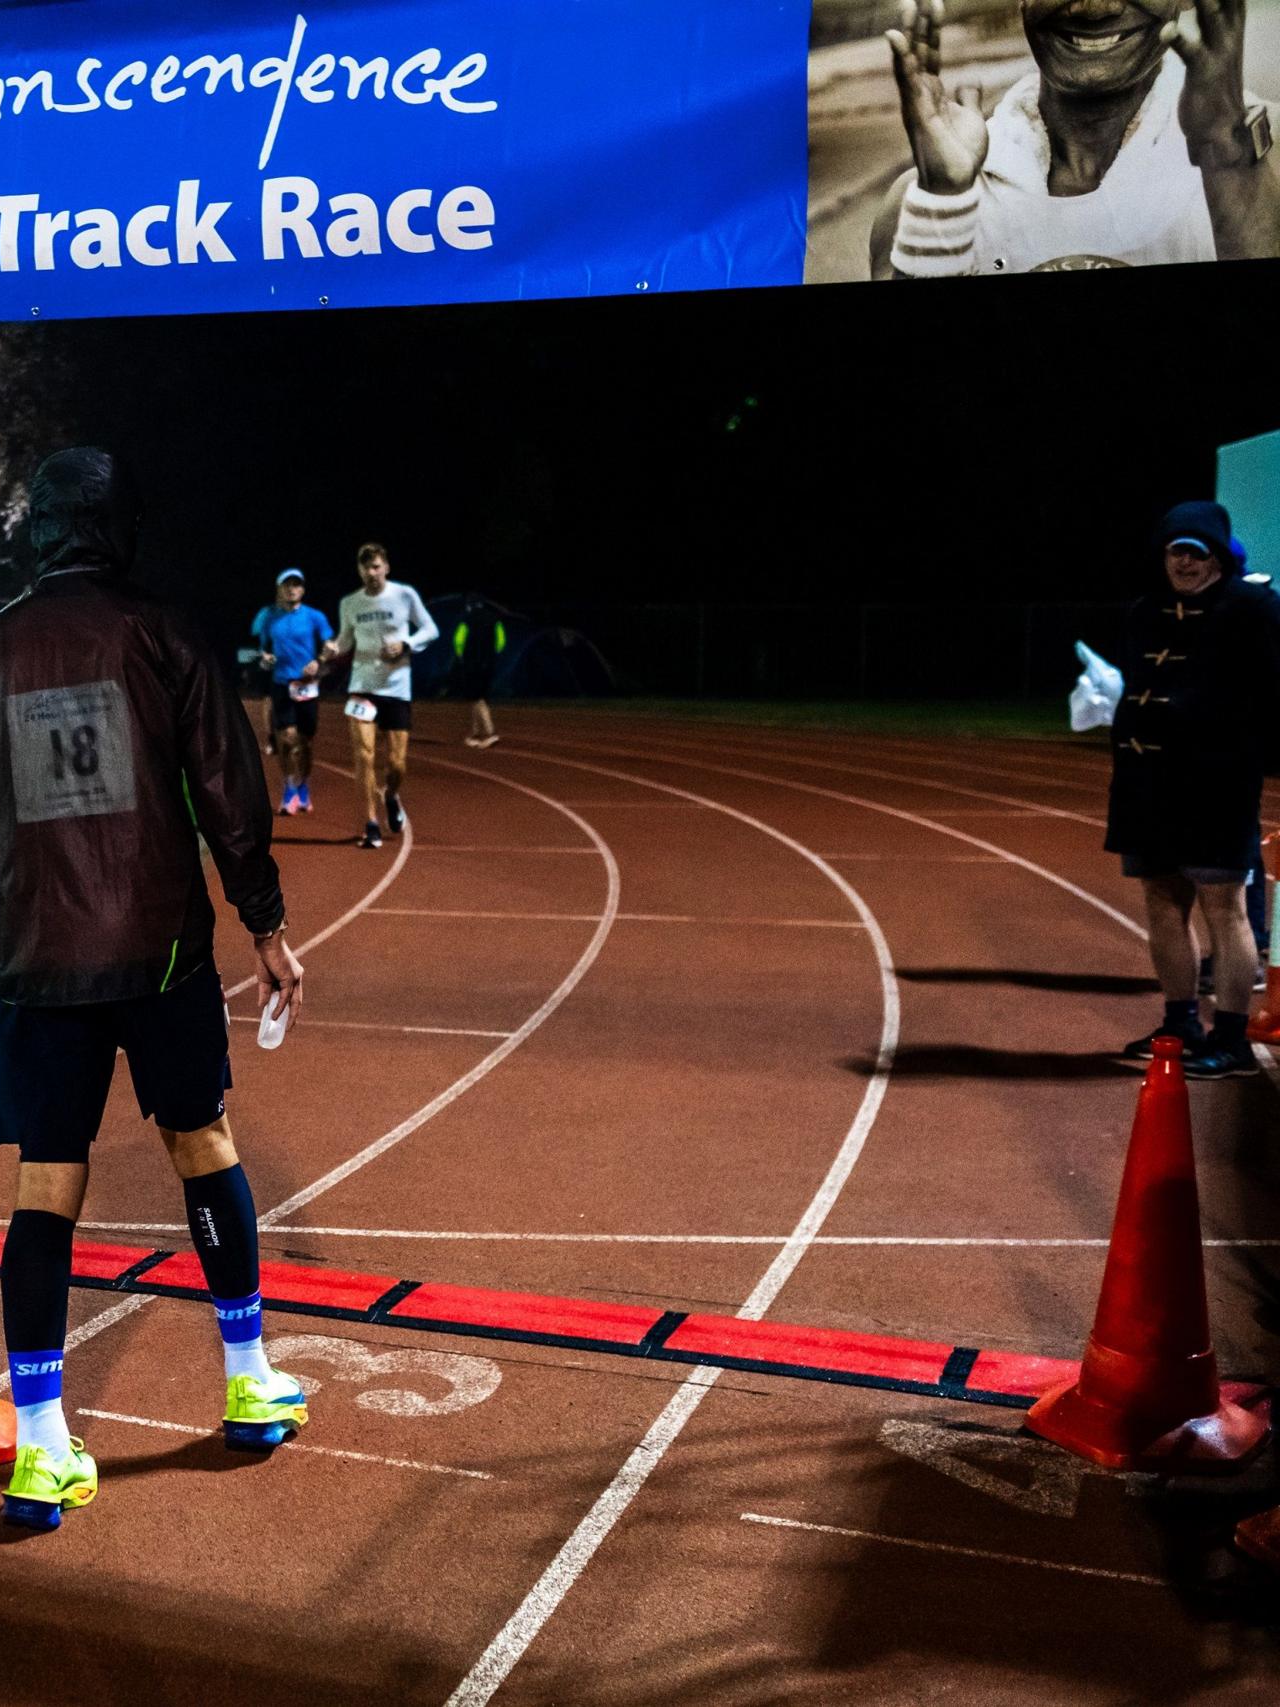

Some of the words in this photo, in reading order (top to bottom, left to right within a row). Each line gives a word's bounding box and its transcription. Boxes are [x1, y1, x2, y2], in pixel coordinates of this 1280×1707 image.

[262, 177, 495, 260] Race
[50, 725, 99, 781] 18
[203, 1207, 220, 1246] SALOMON
[264, 1334, 503, 1416] 3
